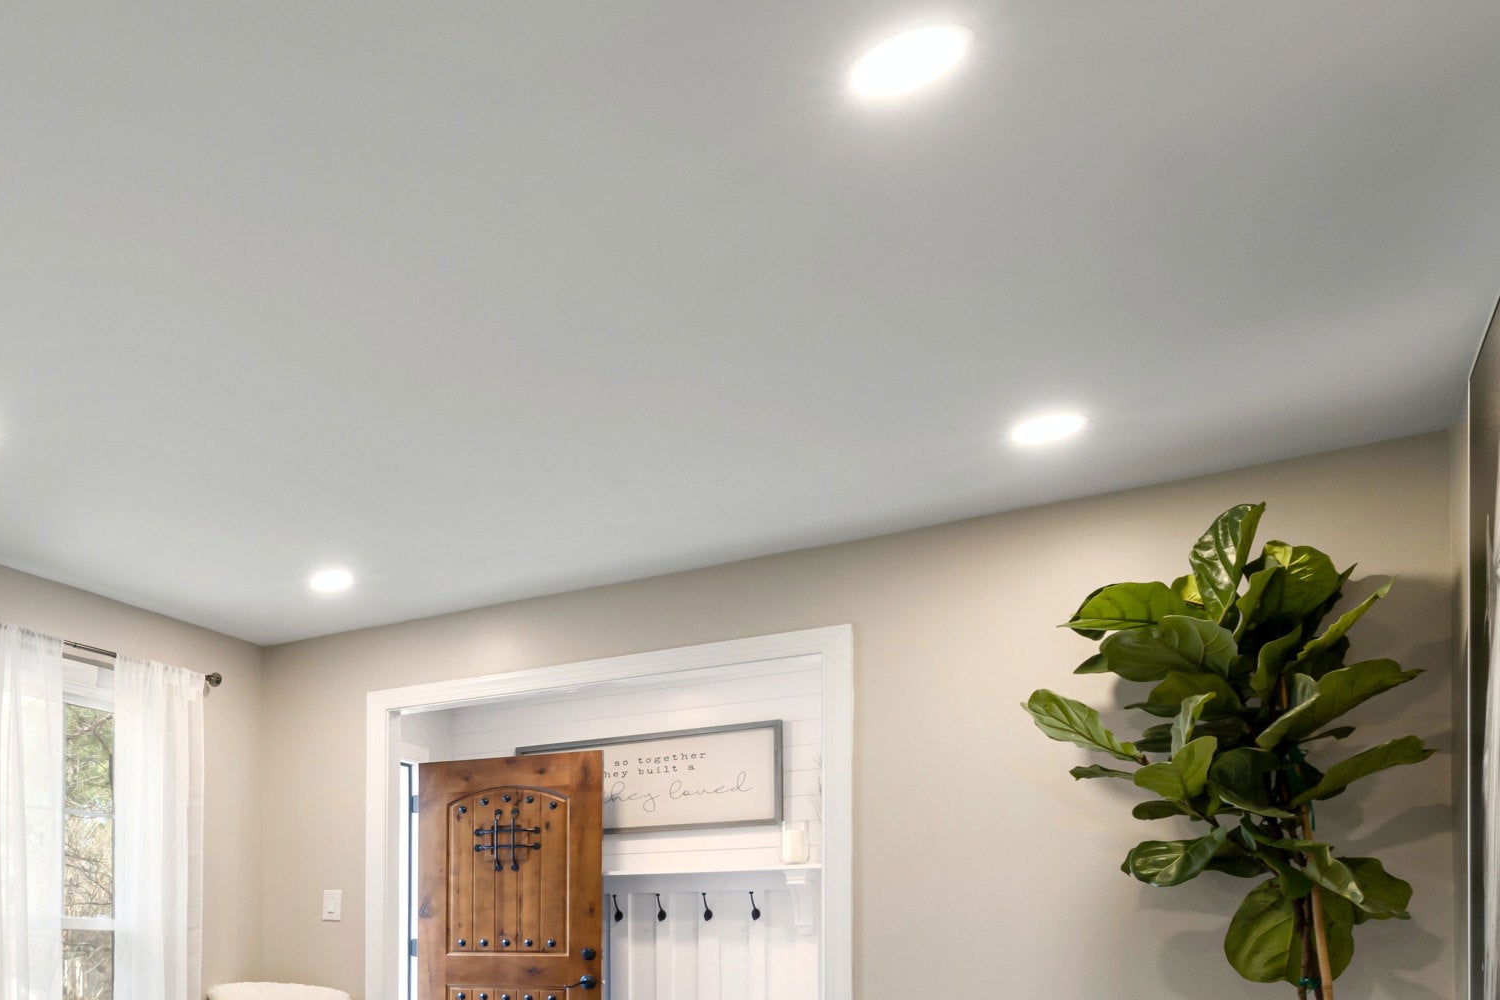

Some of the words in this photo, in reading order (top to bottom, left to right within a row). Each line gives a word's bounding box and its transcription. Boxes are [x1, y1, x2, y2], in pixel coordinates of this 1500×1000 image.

[614, 759, 629, 767] so
[638, 752, 707, 764] together
[604, 770, 628, 778] hey
[637, 765, 678, 775] built
[604, 781, 661, 812] hey
[670, 771, 754, 799] loved
